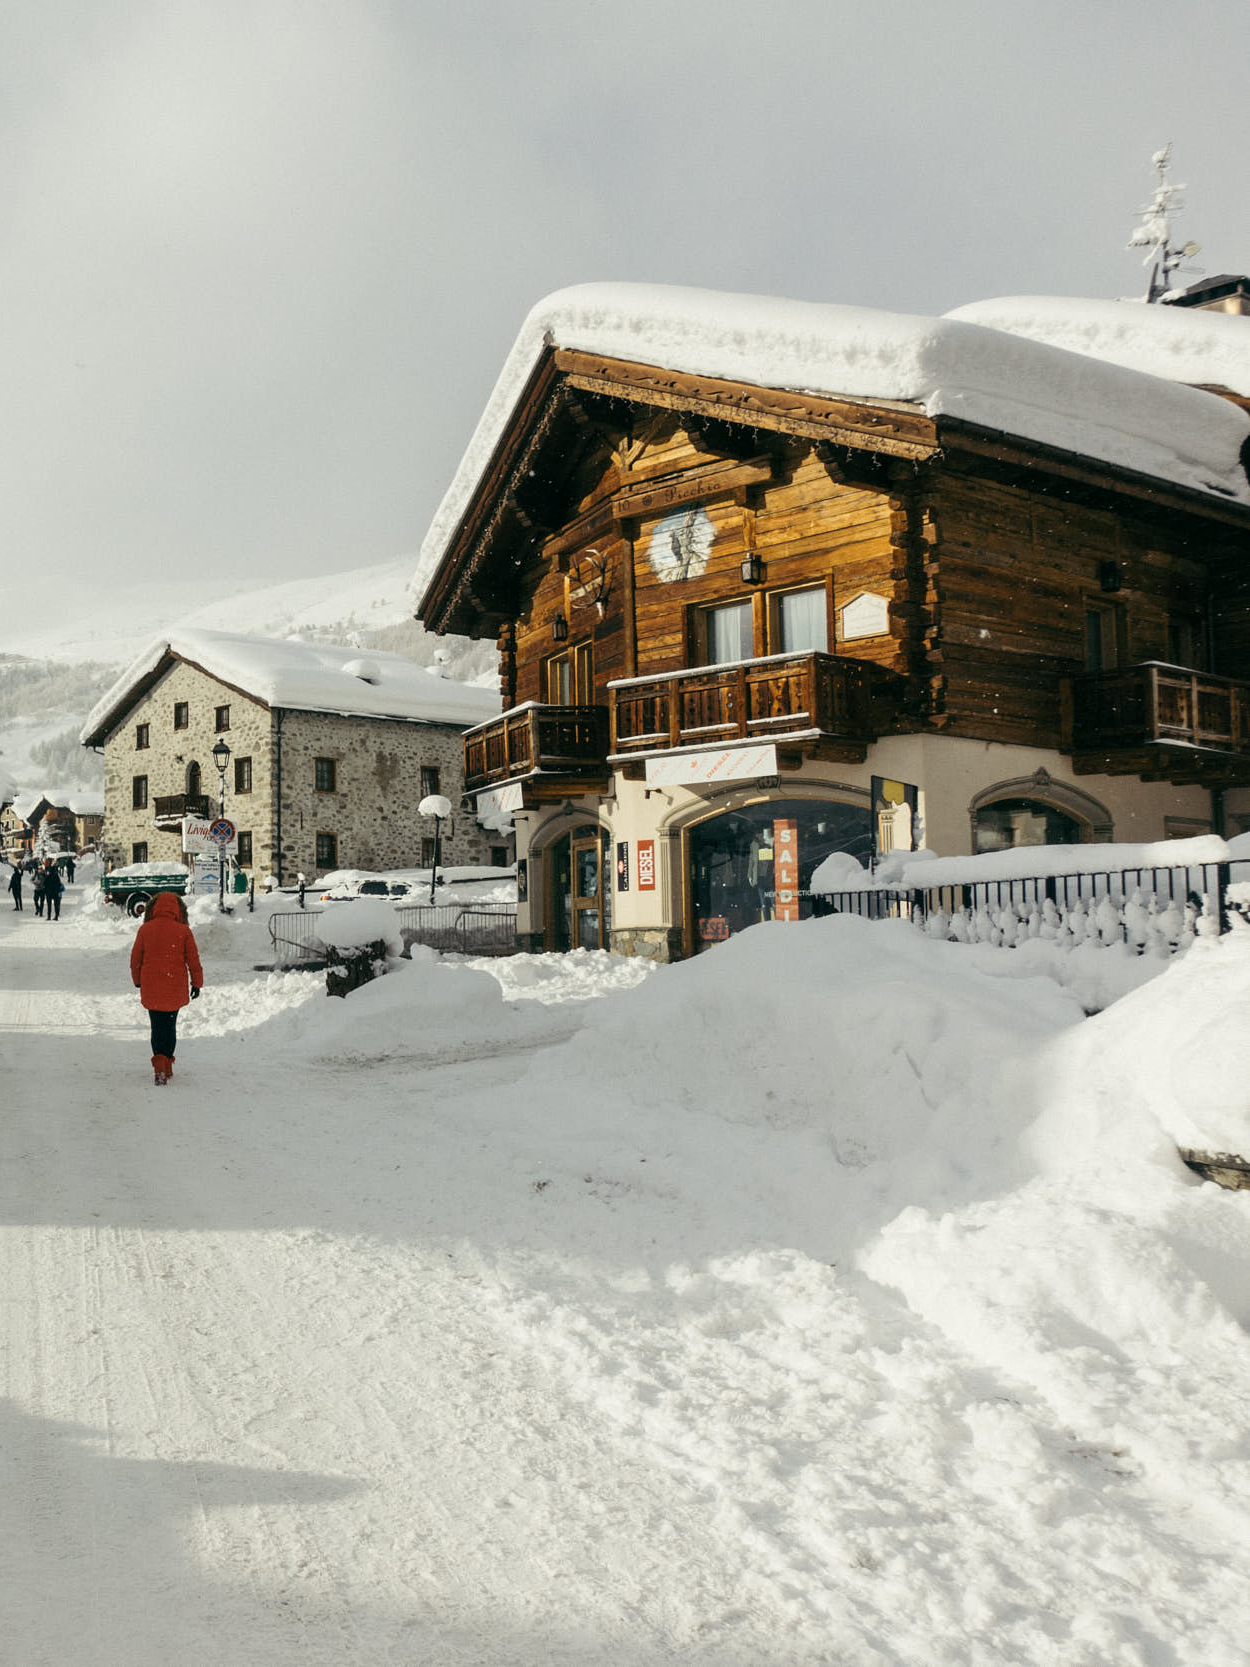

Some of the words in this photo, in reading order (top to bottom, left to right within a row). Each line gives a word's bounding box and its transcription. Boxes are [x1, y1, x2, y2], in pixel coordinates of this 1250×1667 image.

[186, 823, 211, 841] Livig
[639, 845, 653, 885] DIESEL
[780, 829, 792, 922] SALDI
